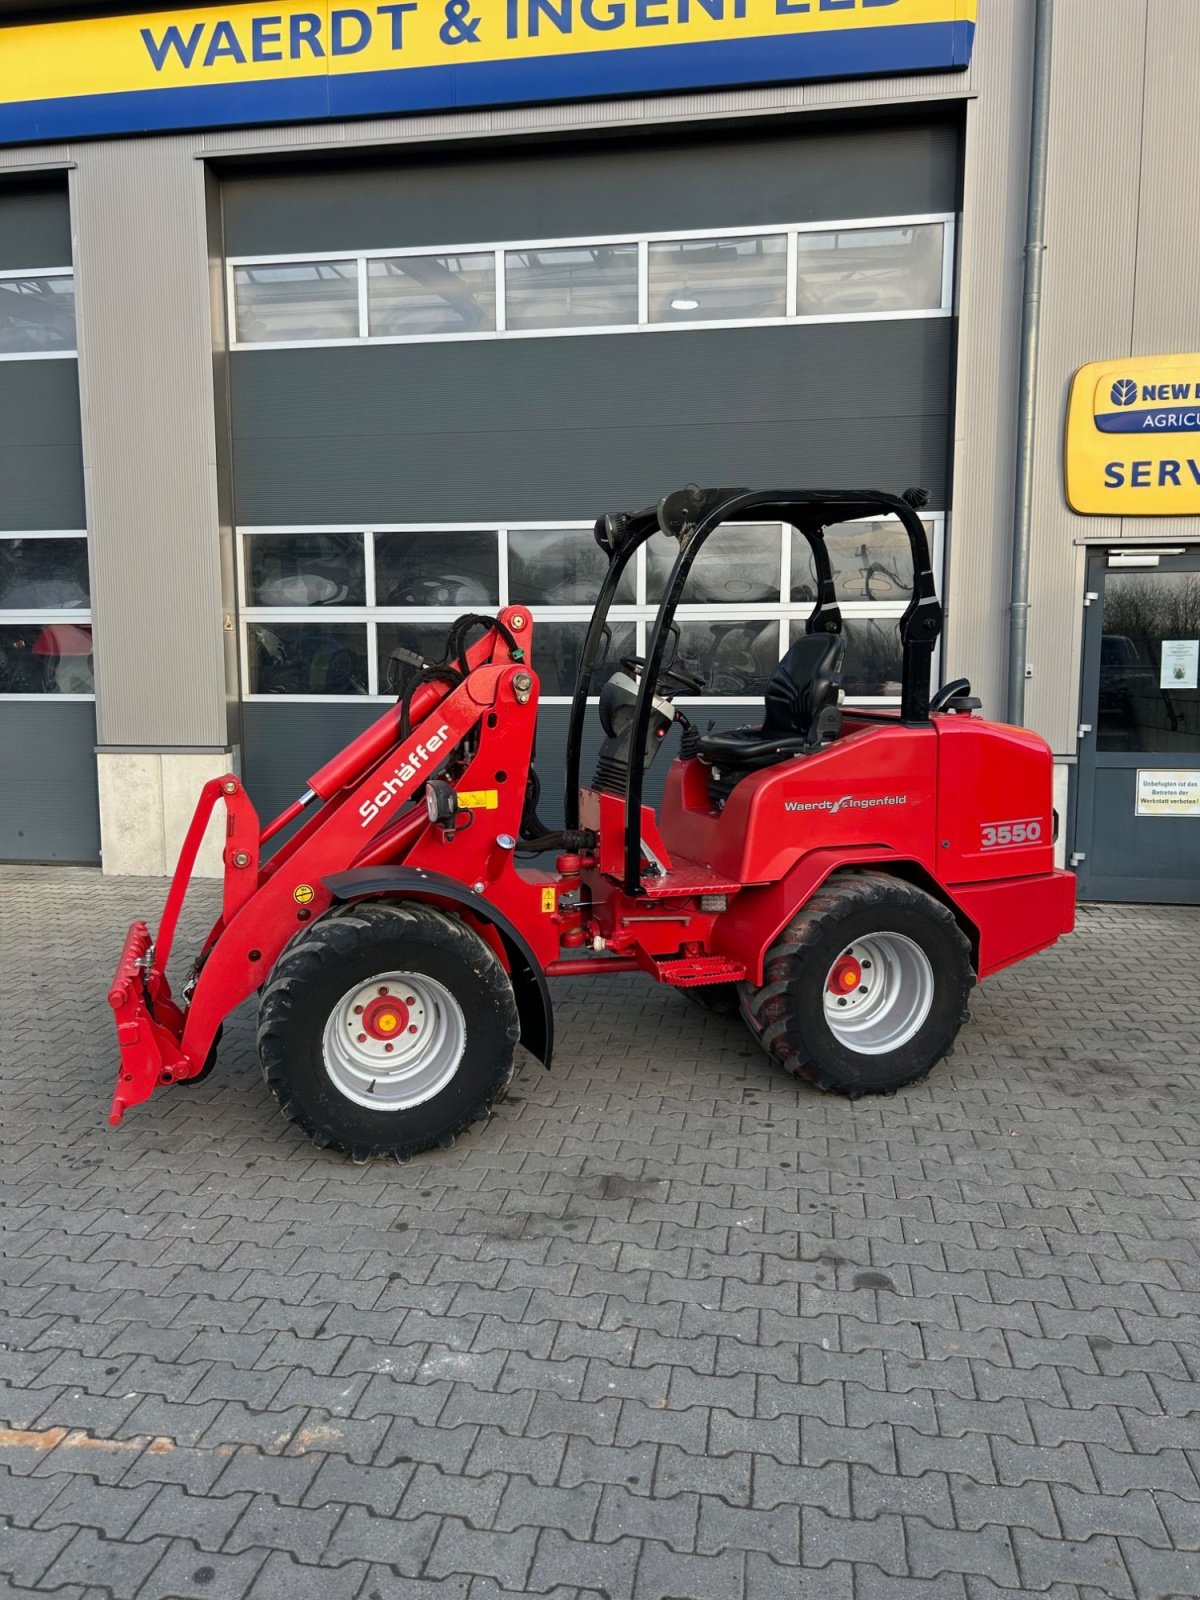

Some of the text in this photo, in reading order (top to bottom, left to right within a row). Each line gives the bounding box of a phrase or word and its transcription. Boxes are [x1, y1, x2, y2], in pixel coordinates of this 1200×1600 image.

[139, 2, 417, 72] WAERDT
[439, 0, 482, 45] &
[1141, 383, 1191, 401] NEW
[358, 724, 449, 828] Schäffer
[1143, 780, 1177, 788] Unbefugten
[784, 800, 832, 812] Waerdt
[849, 795, 907, 809] Ingenfeld
[981, 822, 1041, 847] 3550
